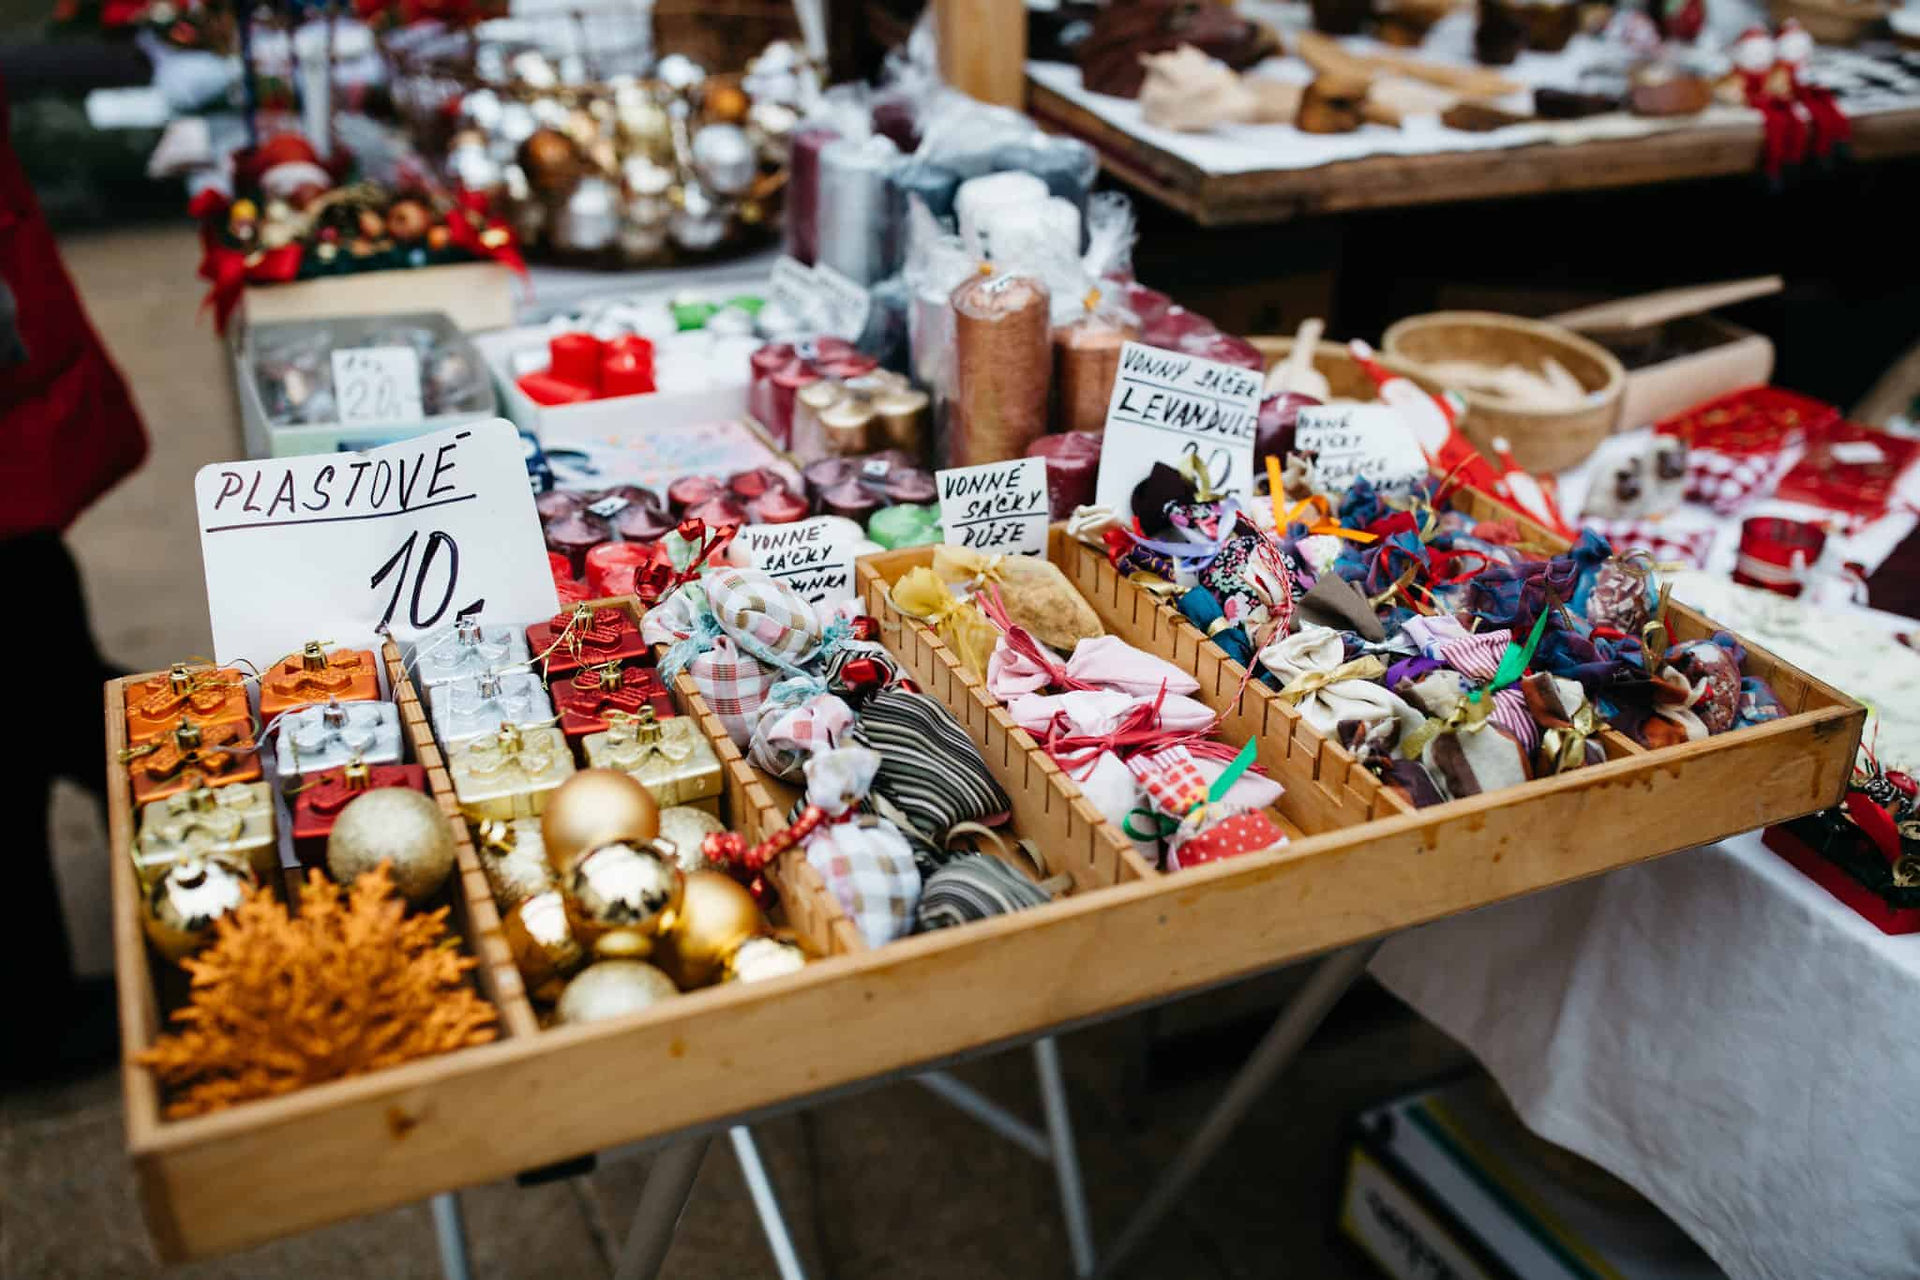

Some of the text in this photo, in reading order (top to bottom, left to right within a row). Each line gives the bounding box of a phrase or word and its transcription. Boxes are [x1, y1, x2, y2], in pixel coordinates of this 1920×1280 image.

[1117, 386, 1258, 439] LEVANDULE
[214, 431, 472, 517] PLASTOVÉ
[945, 463, 1026, 499] VONNÉ
[962, 490, 1042, 518] SÁČKY
[752, 523, 828, 551] VONNÉ
[761, 545, 832, 571] SÁČKY
